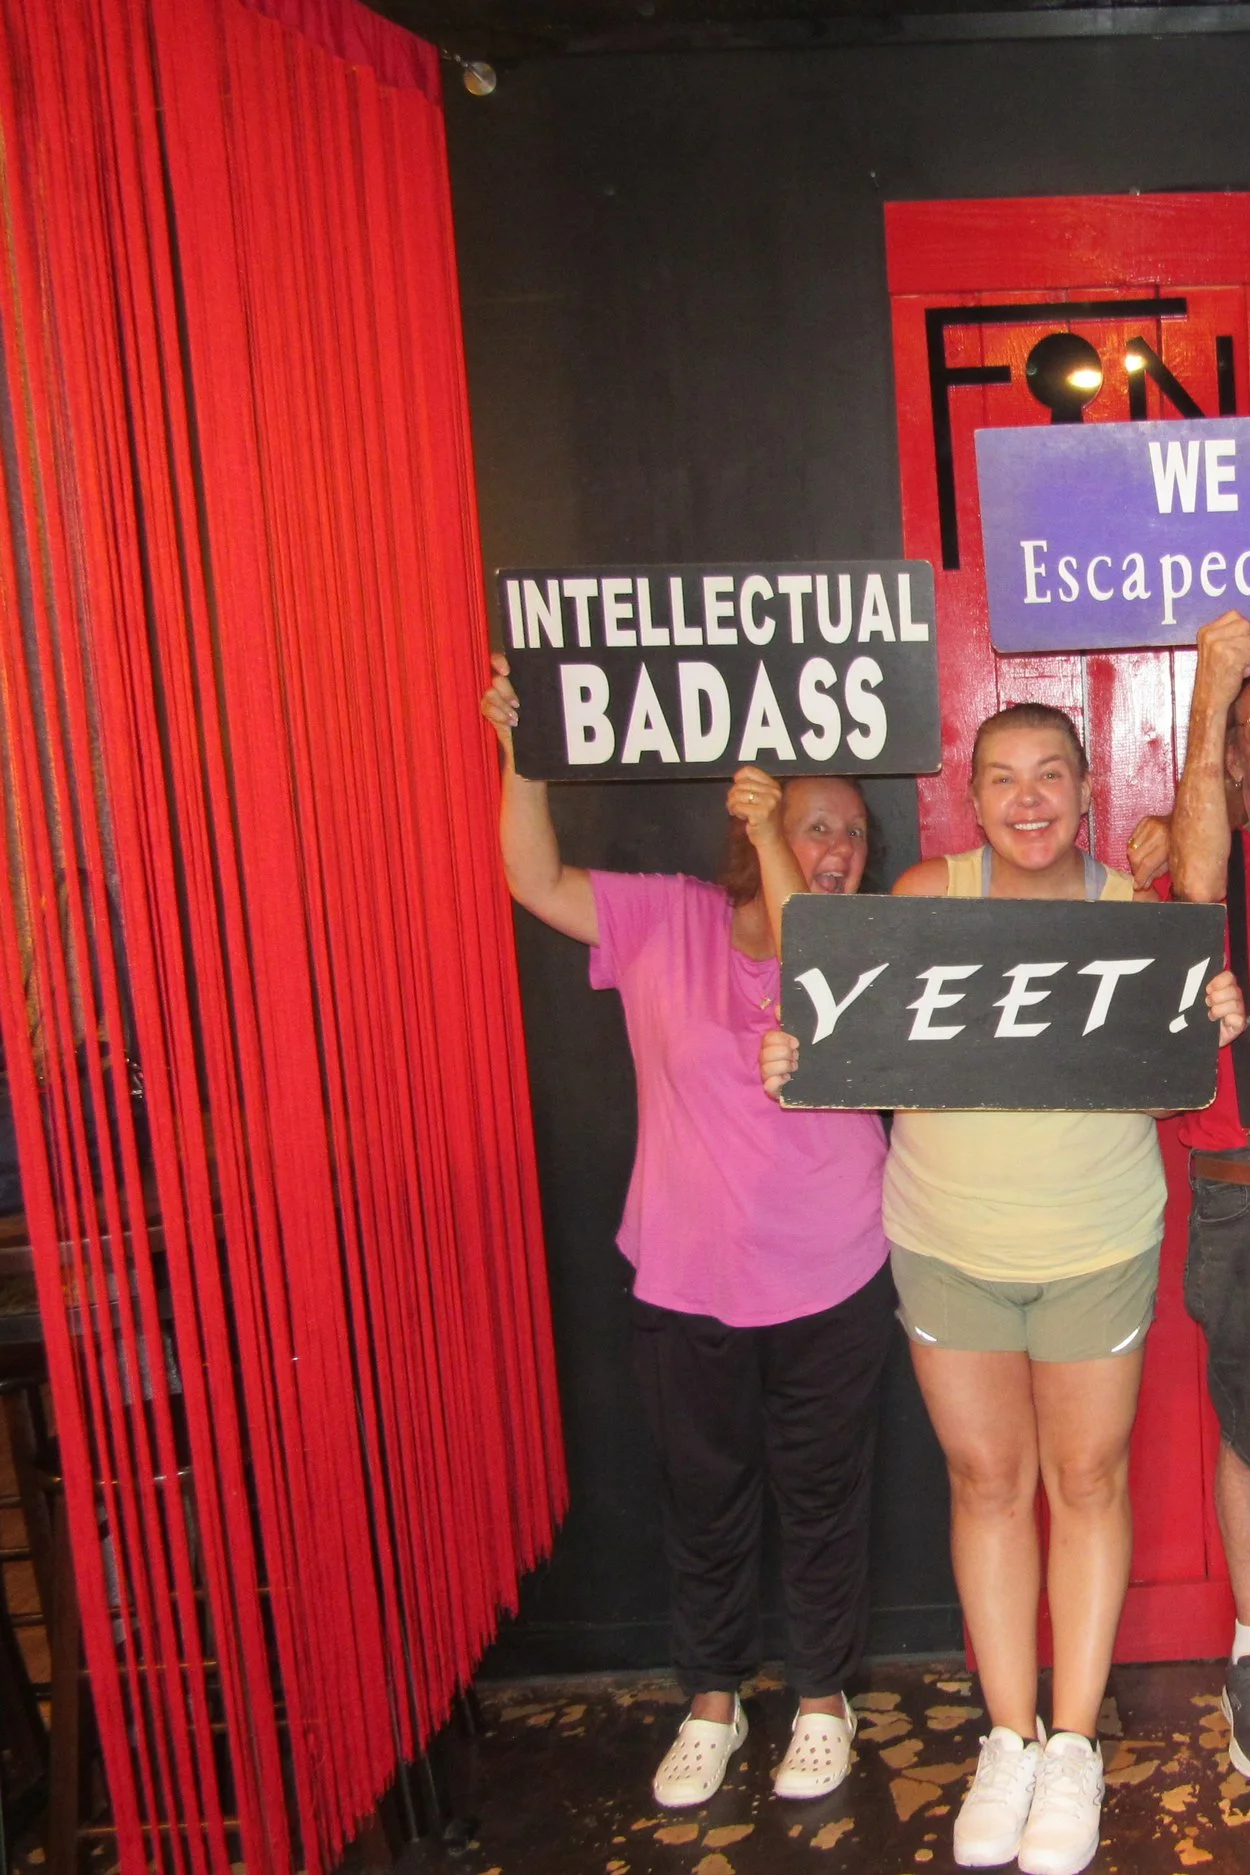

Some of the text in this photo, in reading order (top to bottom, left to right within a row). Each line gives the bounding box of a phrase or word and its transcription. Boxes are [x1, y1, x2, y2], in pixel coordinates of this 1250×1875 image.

[1149, 439, 1239, 514] WE
[506, 573, 929, 649] INTELLECTUAL
[560, 656, 888, 765] BADASS
